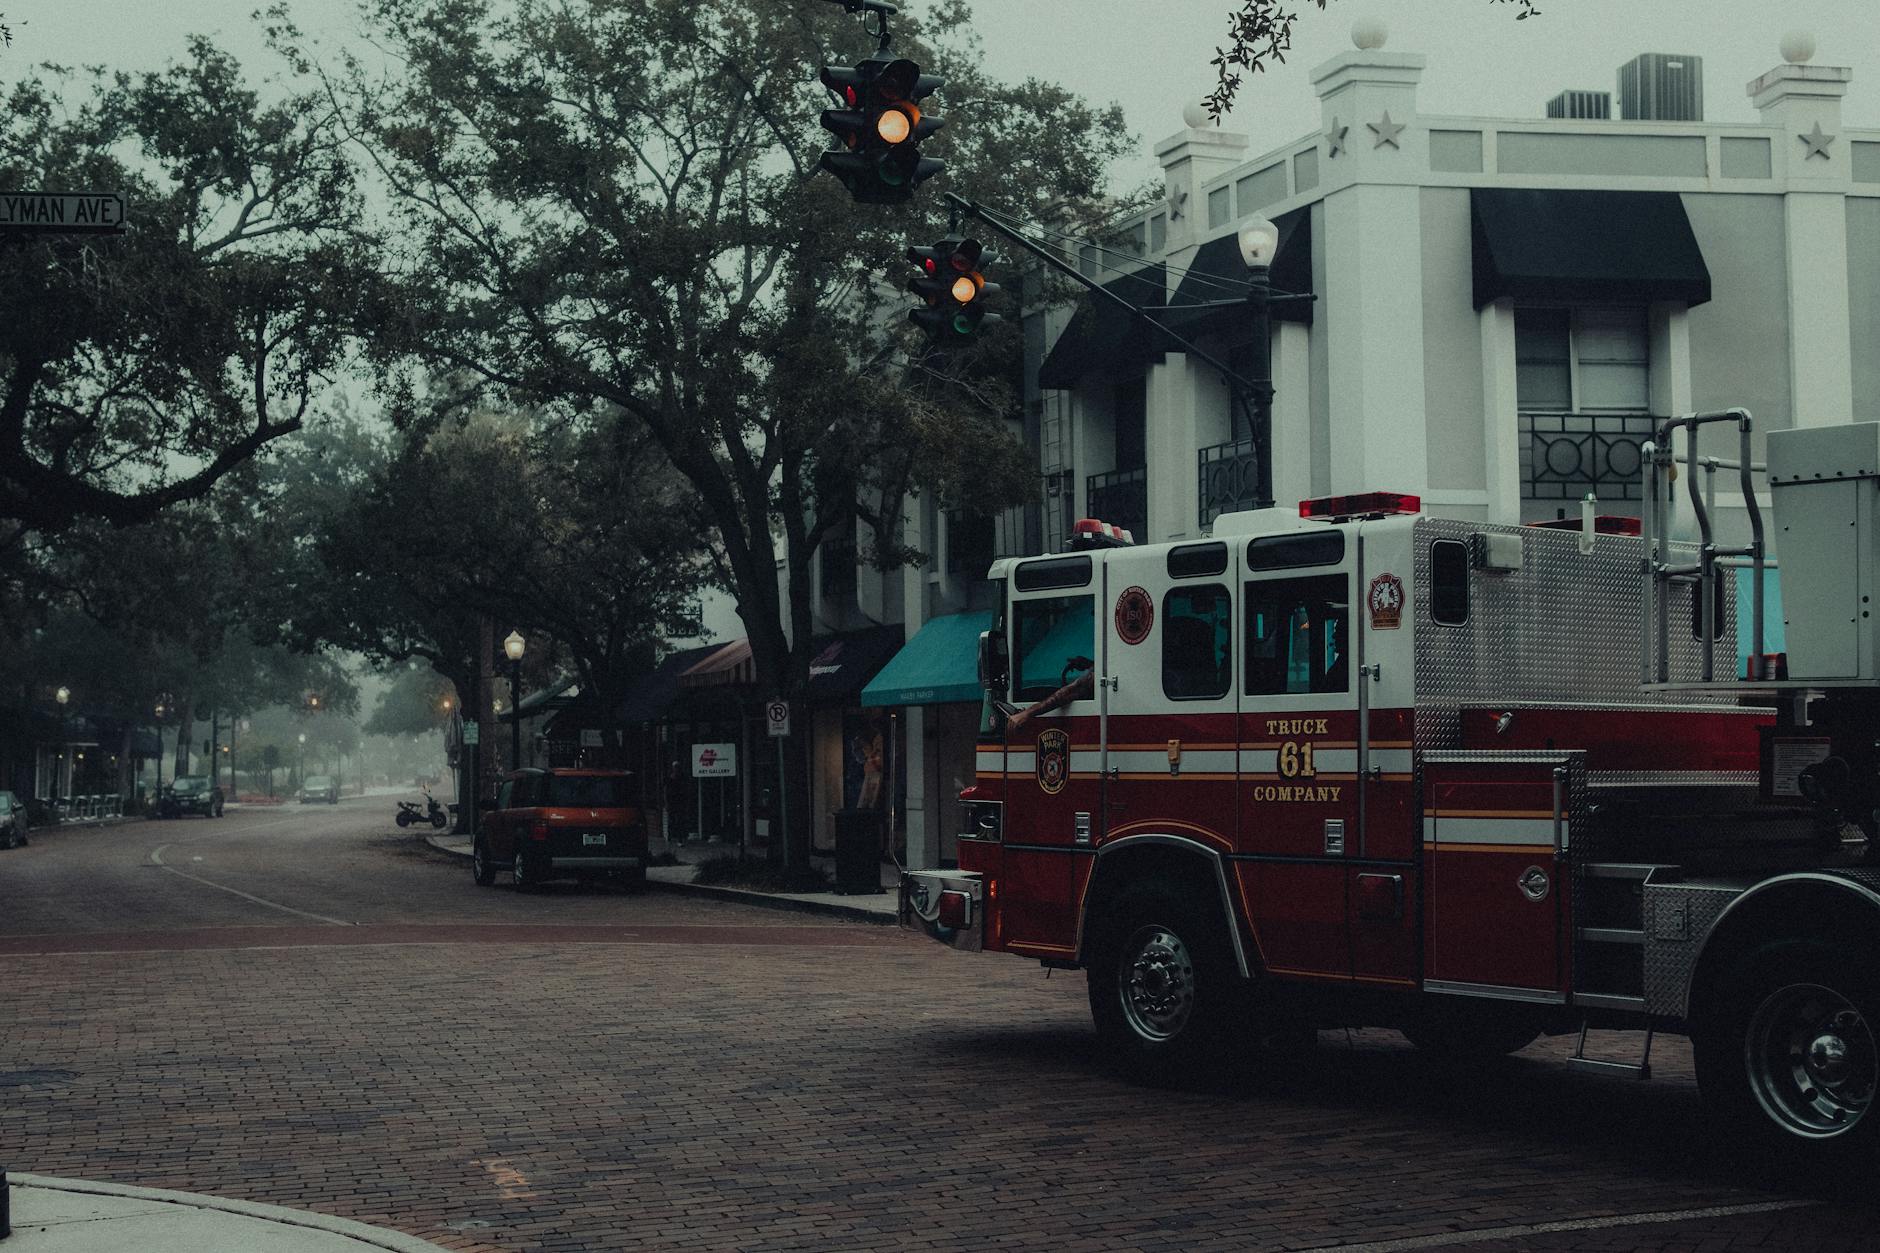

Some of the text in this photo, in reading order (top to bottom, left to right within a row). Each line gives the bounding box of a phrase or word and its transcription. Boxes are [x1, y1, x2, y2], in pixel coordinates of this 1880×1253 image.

[75, 198, 113, 223] AVE
[1266, 718, 1329, 736] TRUCK
[1040, 732, 1066, 745] WINTER
[1043, 739, 1062, 753] PARK
[1279, 741, 1316, 777] 61
[1253, 786, 1342, 802] COMPANY
